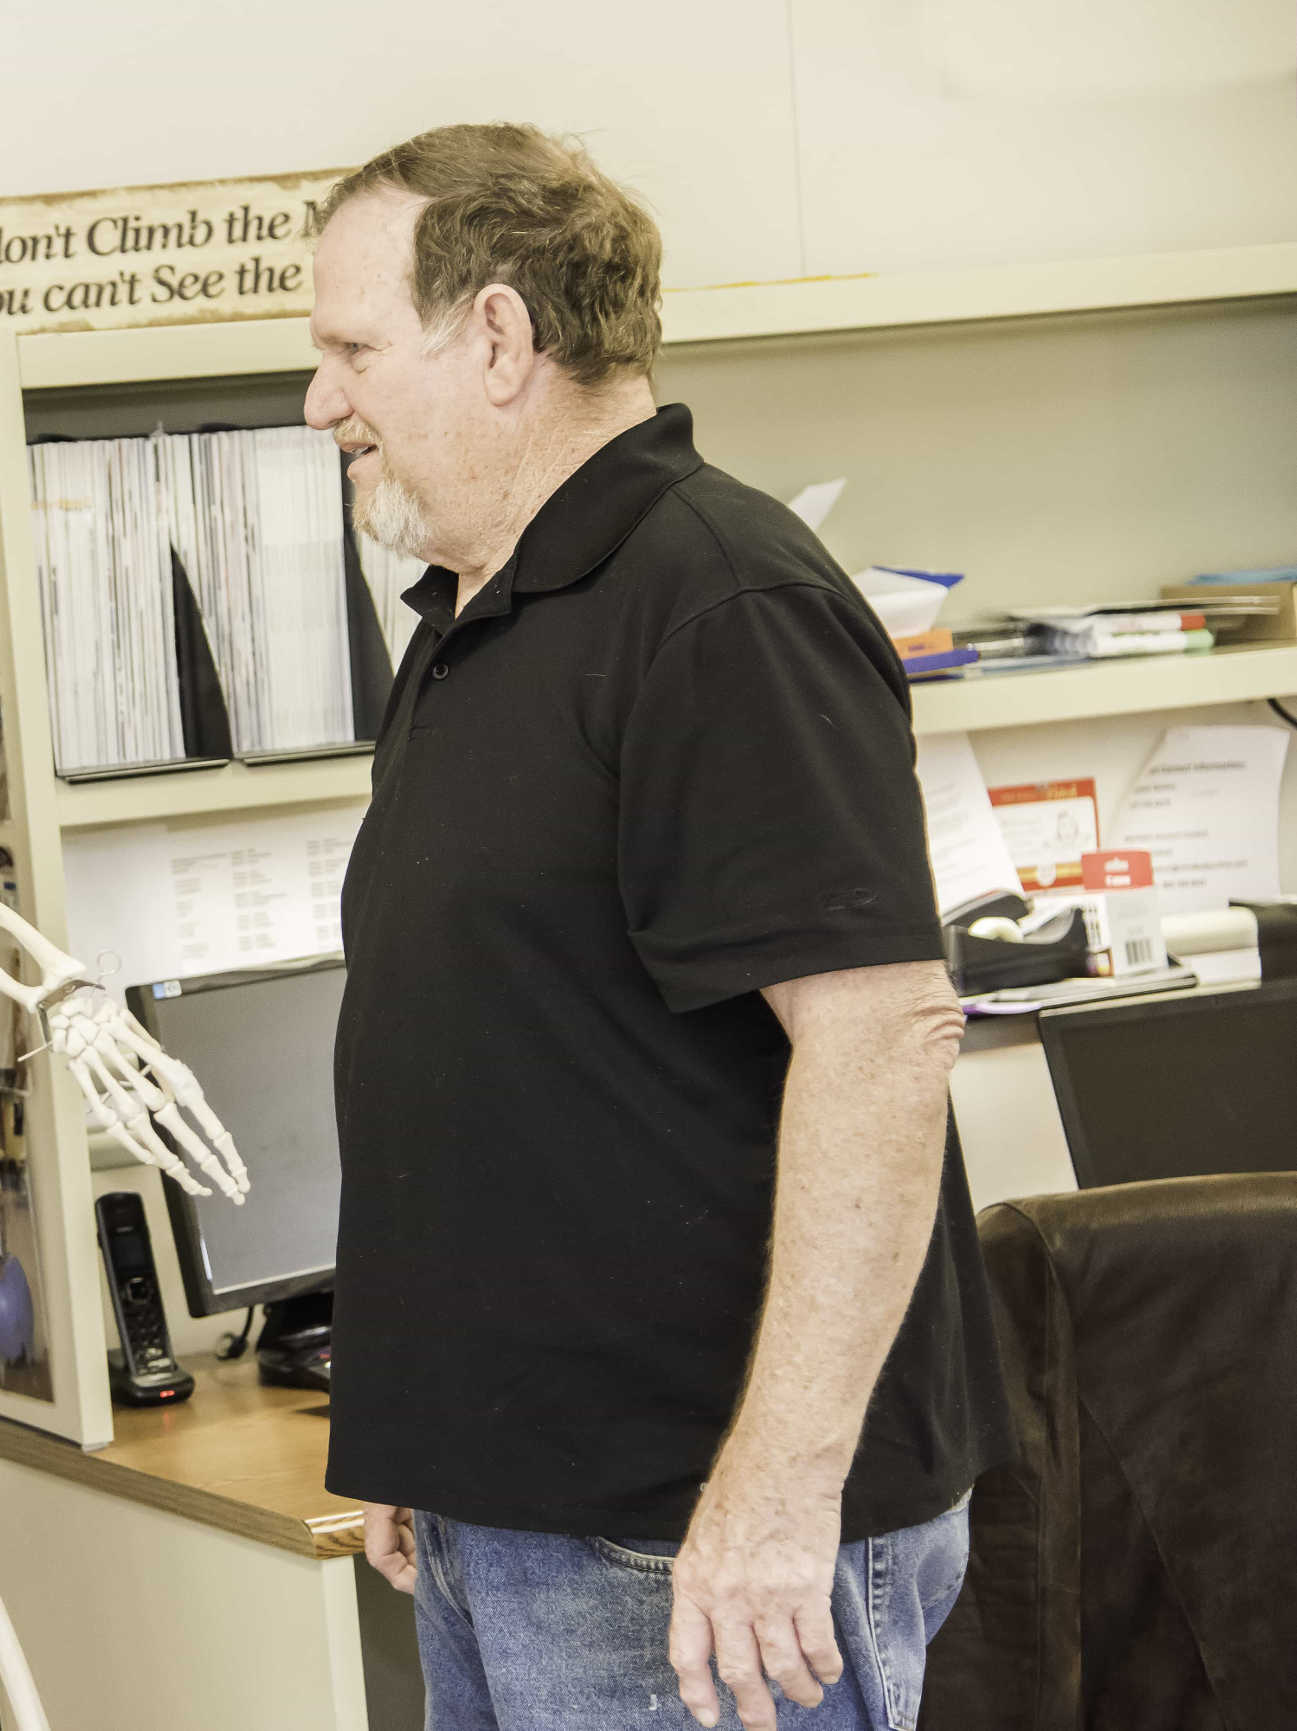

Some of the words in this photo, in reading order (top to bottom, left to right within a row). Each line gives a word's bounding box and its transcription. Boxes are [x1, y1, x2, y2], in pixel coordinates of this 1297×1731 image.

[87, 208, 213, 256] Climb
[226, 204, 291, 245] the
[43, 269, 141, 311] can't
[151, 264, 225, 303] See
[235, 255, 303, 296] the
